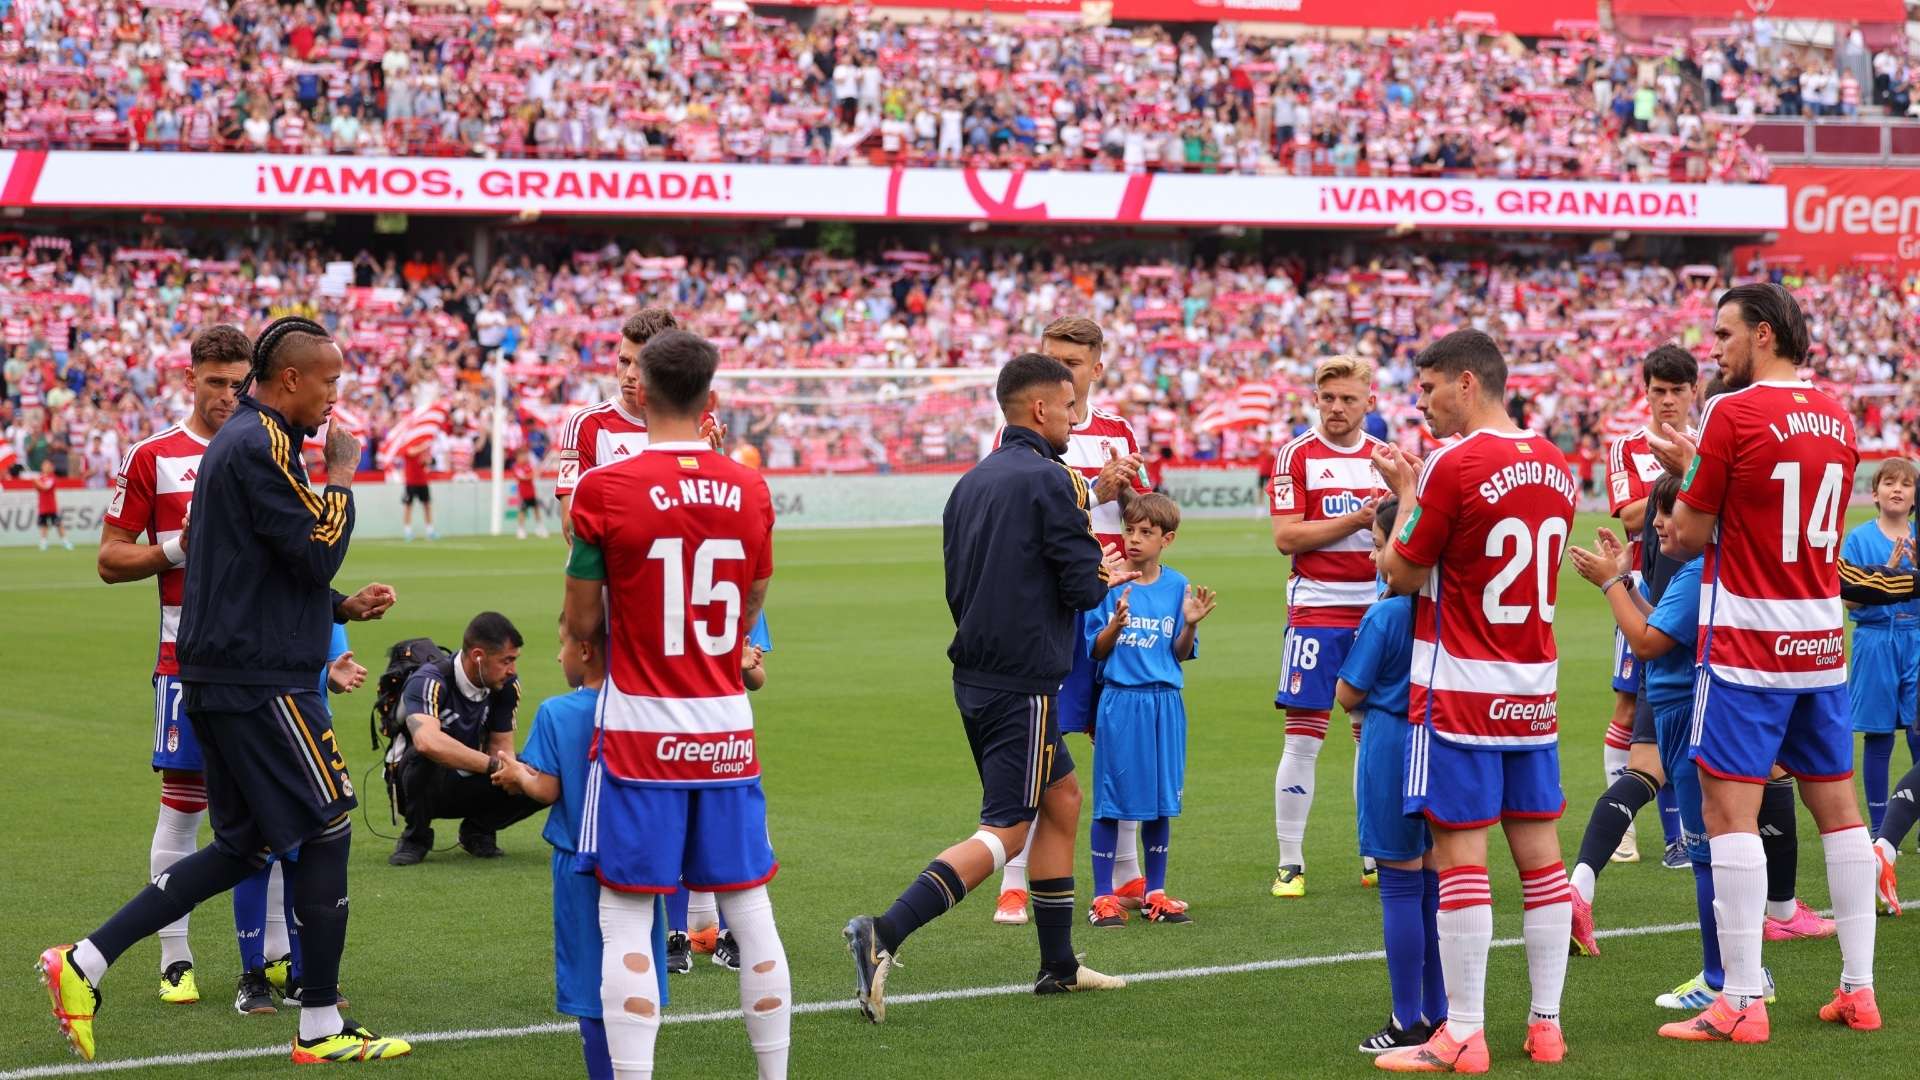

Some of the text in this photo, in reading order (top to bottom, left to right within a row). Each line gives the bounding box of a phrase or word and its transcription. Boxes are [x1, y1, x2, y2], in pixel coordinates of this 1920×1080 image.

[258, 166, 731, 200] ¡VAMOS, GRANADA!
[1320, 188, 1697, 217] ¡VAMOS, GRANADA!
[1769, 412, 1847, 446] I. MIQUEL
[649, 485, 679, 511] C.
[678, 479, 741, 512] NEVA
[1479, 461, 1575, 507] SERGIO RUIZ
[1770, 461, 1844, 563] 14
[1482, 516, 1567, 624] 20
[646, 537, 746, 656] 15
[1293, 634, 1320, 670] 18
[1815, 655, 1838, 667] Group
[169, 682, 183, 720] 7
[321, 728, 345, 771] 3
[656, 734, 753, 764] Greening
[712, 761, 744, 774] Group
